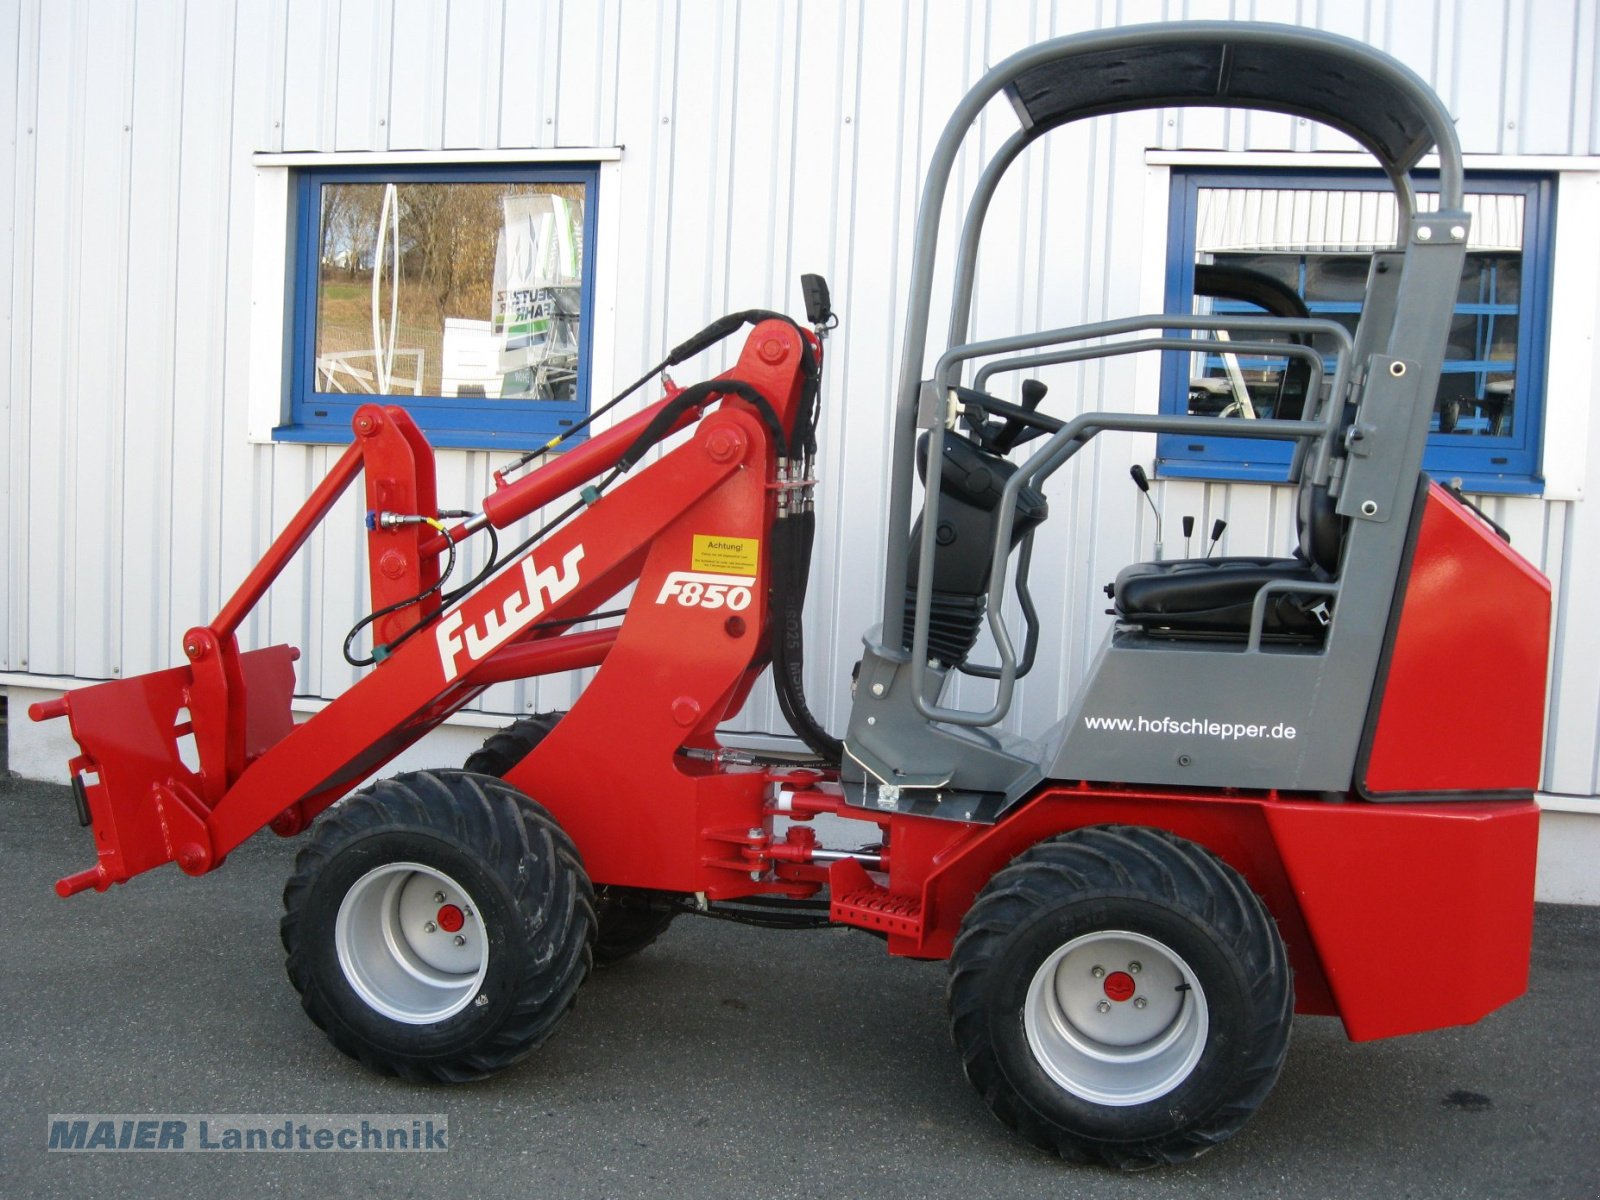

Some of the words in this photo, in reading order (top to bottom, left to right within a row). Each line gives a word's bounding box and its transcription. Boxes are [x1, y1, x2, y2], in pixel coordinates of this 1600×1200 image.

[708, 541, 743, 552] Achtung!
[655, 571, 757, 611] F850
[435, 543, 585, 683] Fuchs
[1084, 716, 1297, 740] www.hofschlepper.de
